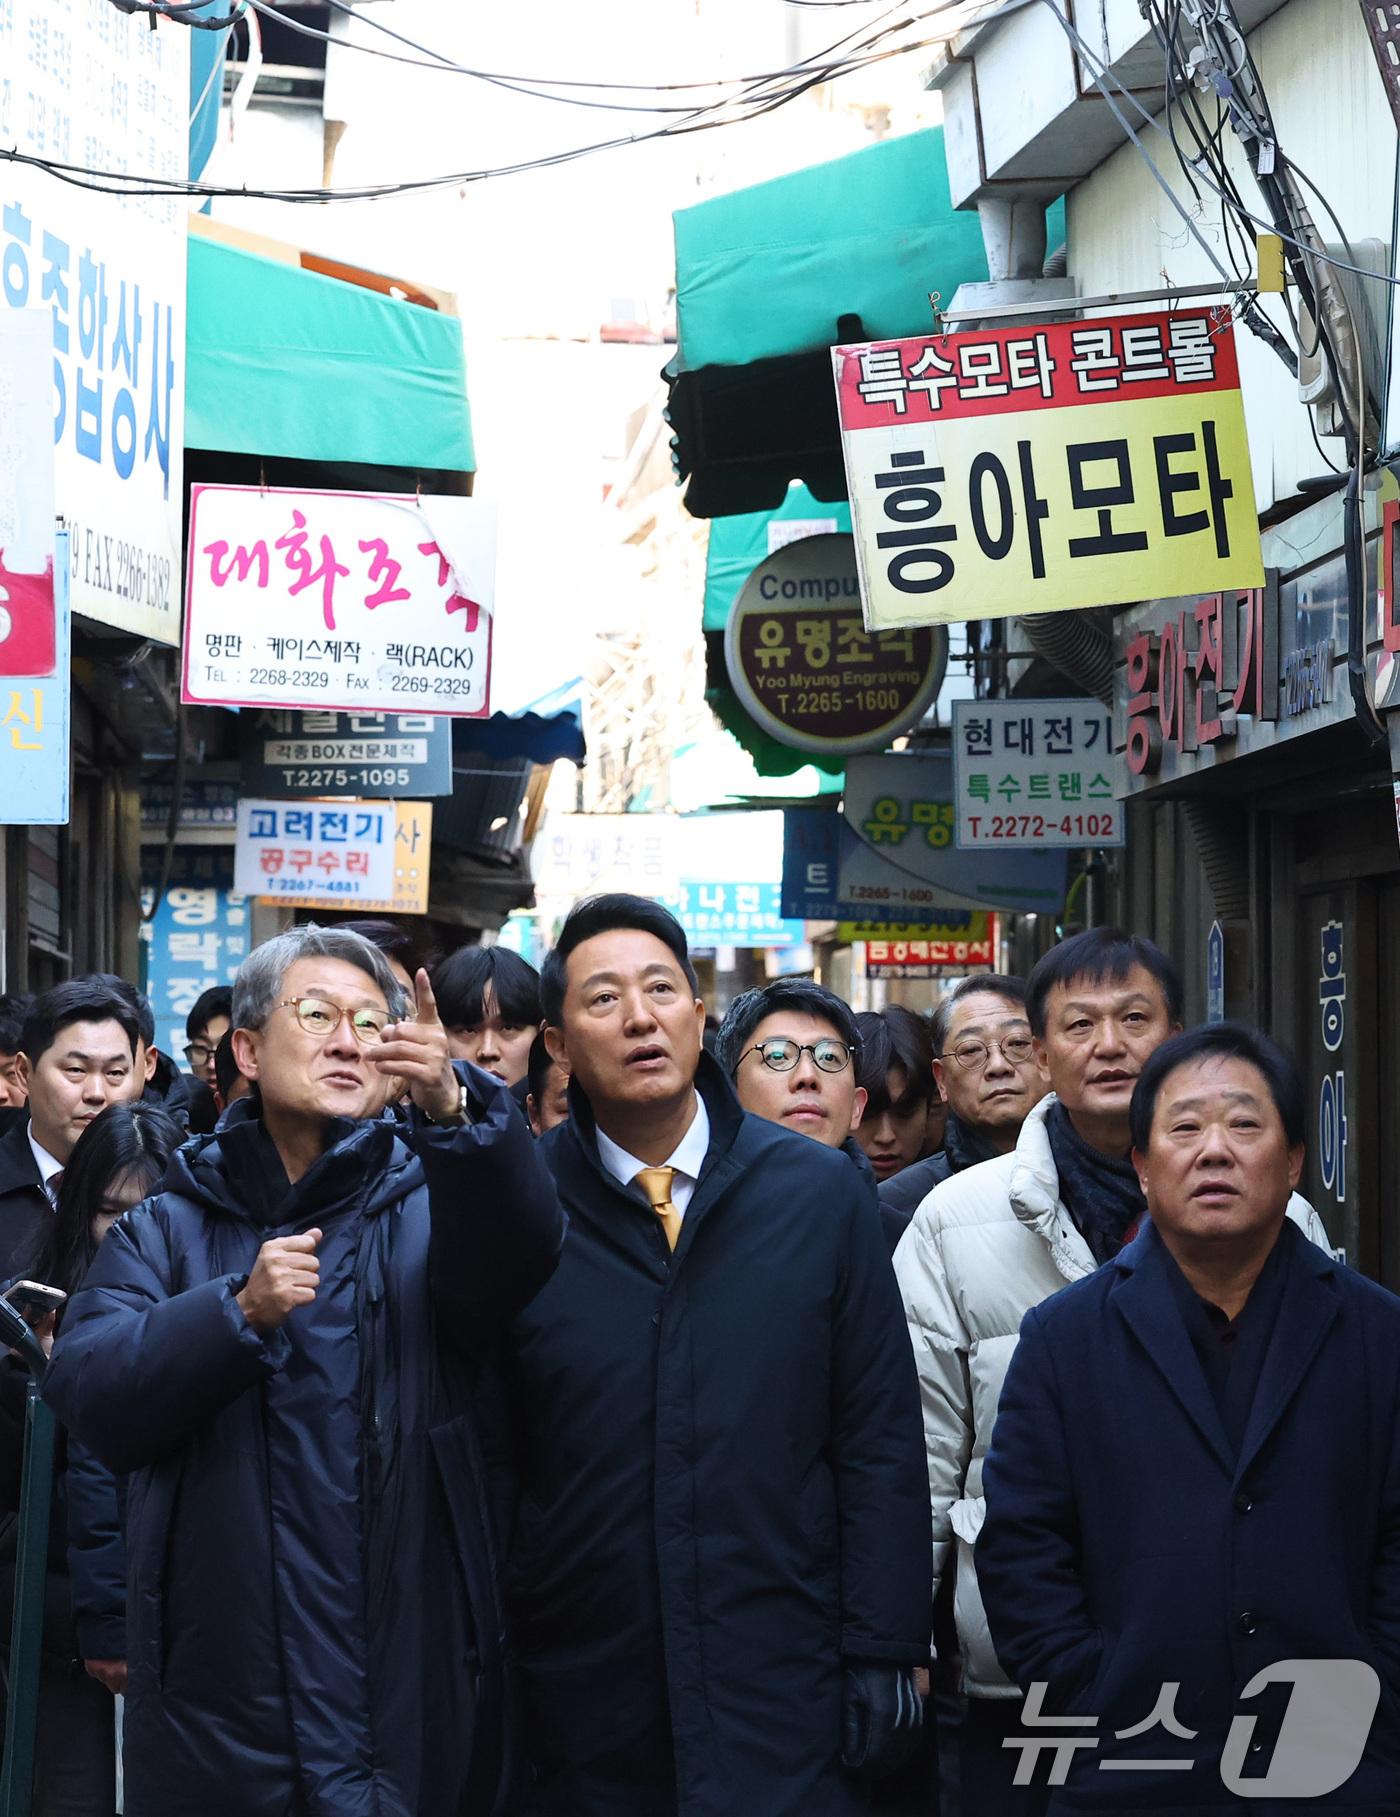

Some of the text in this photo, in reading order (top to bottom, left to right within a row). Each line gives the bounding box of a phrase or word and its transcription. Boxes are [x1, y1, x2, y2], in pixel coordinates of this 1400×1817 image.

[857, 317, 1216, 413] 특수모타 콘트롤
[874, 420, 1234, 594] 흥아모타
[84, 528, 113, 592] FAX
[116, 540, 170, 612] 2266-1382
[205, 634, 474, 669] 명판 케이스제작 랙(RACK)
[754, 618, 914, 669] 유명조각
[249, 668, 329, 688] 2268-2329
[391, 675, 471, 695] 2269-2329
[756, 671, 922, 689] Yoo Myung Engraving
[1126, 588, 1263, 775] 흥아전기
[777, 690, 900, 714] T.2265-1600
[963, 716, 1114, 756] 현대전기
[283, 769, 410, 787] T.2275-1095
[967, 773, 1113, 803] 특수트랜스
[249, 810, 383, 844] 고려전기
[967, 814, 1114, 838] T.2272-4102
[259, 848, 370, 876] 공구수리
[849, 885, 933, 902] T.2265-1600
